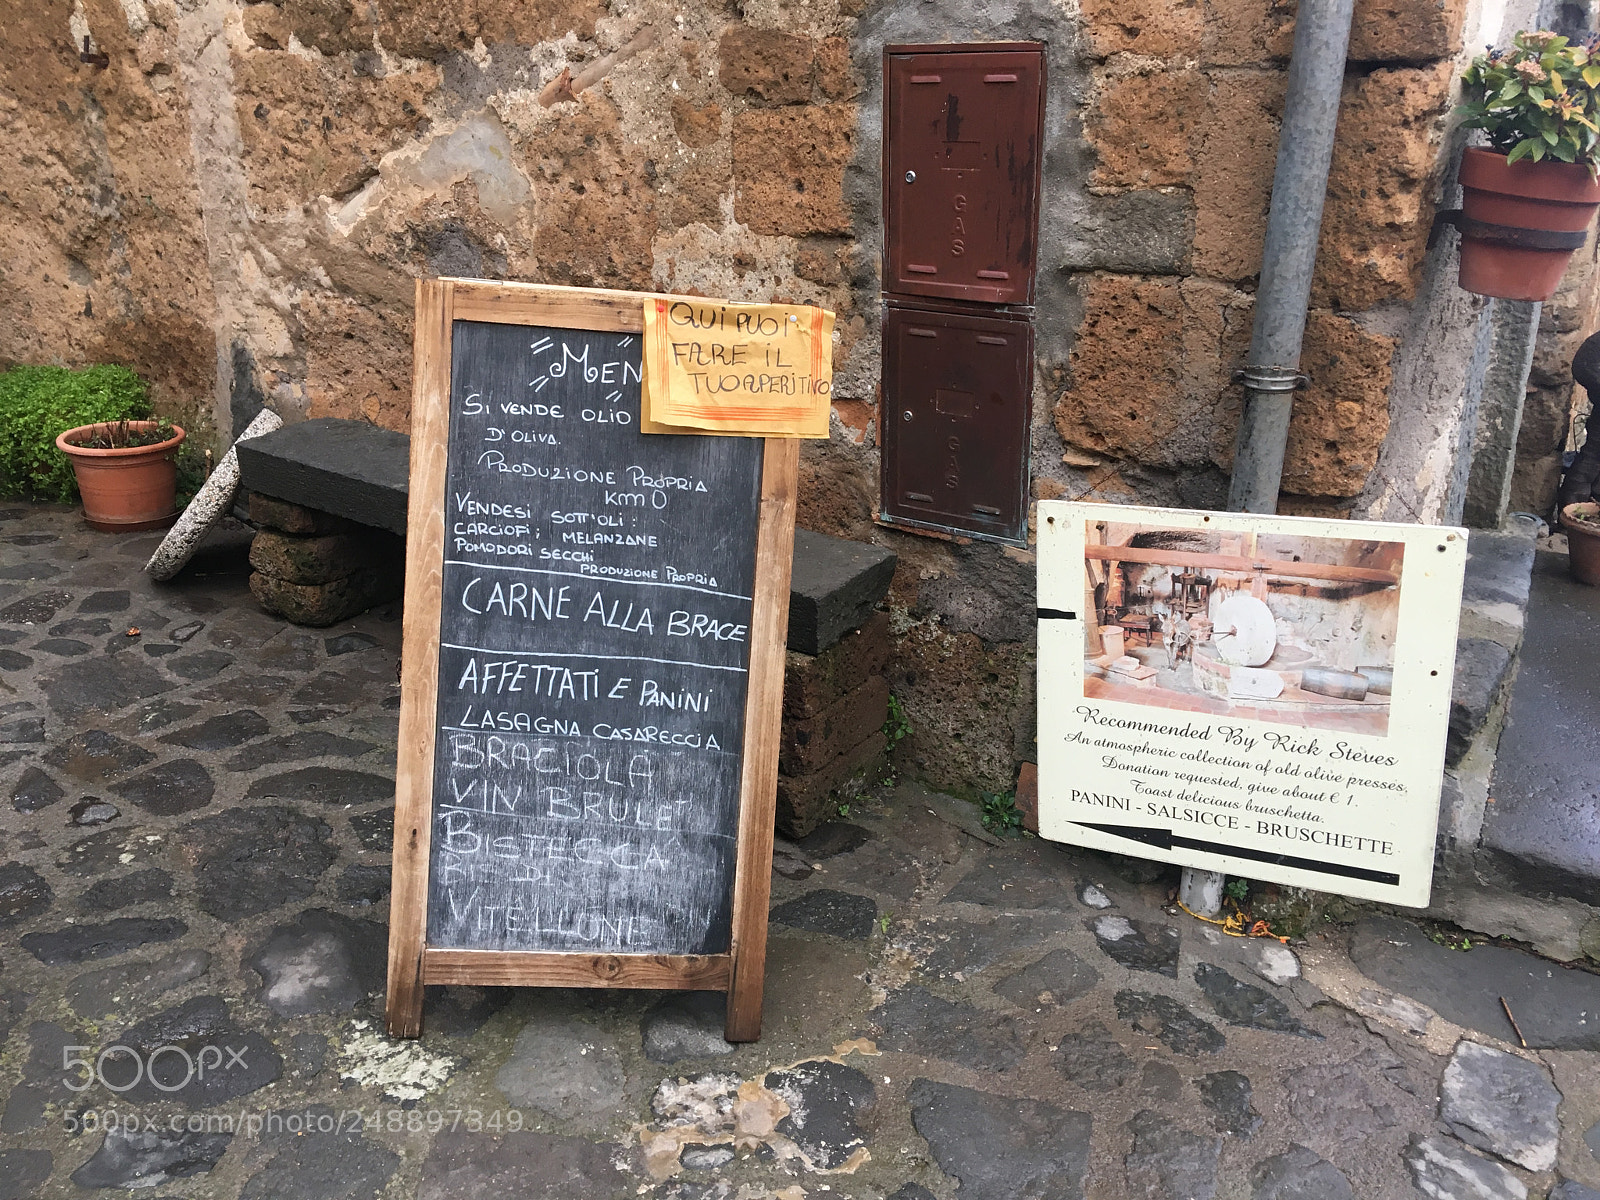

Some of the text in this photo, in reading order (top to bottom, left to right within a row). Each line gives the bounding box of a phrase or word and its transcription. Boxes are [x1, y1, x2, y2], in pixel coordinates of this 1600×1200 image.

[951, 193, 967, 256] GAS
[669, 301, 726, 332] QUI
[549, 342, 643, 385] MEN
[671, 341, 793, 368] FARE IL
[462, 393, 632, 425] SI VENDE OLIO
[477, 449, 709, 493] PRODUZIONE PROPRIA
[945, 434, 961, 489] GAS
[455, 491, 531, 519] VENDESI
[453, 537, 594, 563] POMODORI SECCHI
[562, 531, 658, 548] MELANZANE
[580, 563, 719, 588] PRODUZIONE PROPRIA
[461, 577, 749, 643] CARNE ALLA BRACE
[458, 657, 714, 713] AFFETTATI E PANINI
[459, 704, 721, 751] LASAGNA CASARECCIA
[1076, 705, 1400, 767] Recommended By Rick Steves
[450, 734, 653, 789] BRACIOLA
[1064, 730, 1092, 746] An
[1094, 737, 1177, 758] atmospheric
[1180, 748, 1253, 772] collection
[1255, 758, 1273, 777] of
[1275, 762, 1302, 777] old
[1304, 766, 1346, 784] olive
[1101, 755, 1172, 779] Donation
[1174, 771, 1244, 791] requested,
[1247, 782, 1281, 796] give
[1282, 784, 1326, 803] about
[1329, 790, 1341, 805] €
[452, 776, 521, 815] VIN
[1130, 779, 1326, 824] Toast delicious bruschetta.
[437, 814, 670, 871] BISTECCA
[1070, 789, 1131, 812] PANINI
[1147, 802, 1240, 830] SALSICCE
[1256, 820, 1394, 856] BRUSCHETTE
[448, 885, 653, 946] VITELLONE
